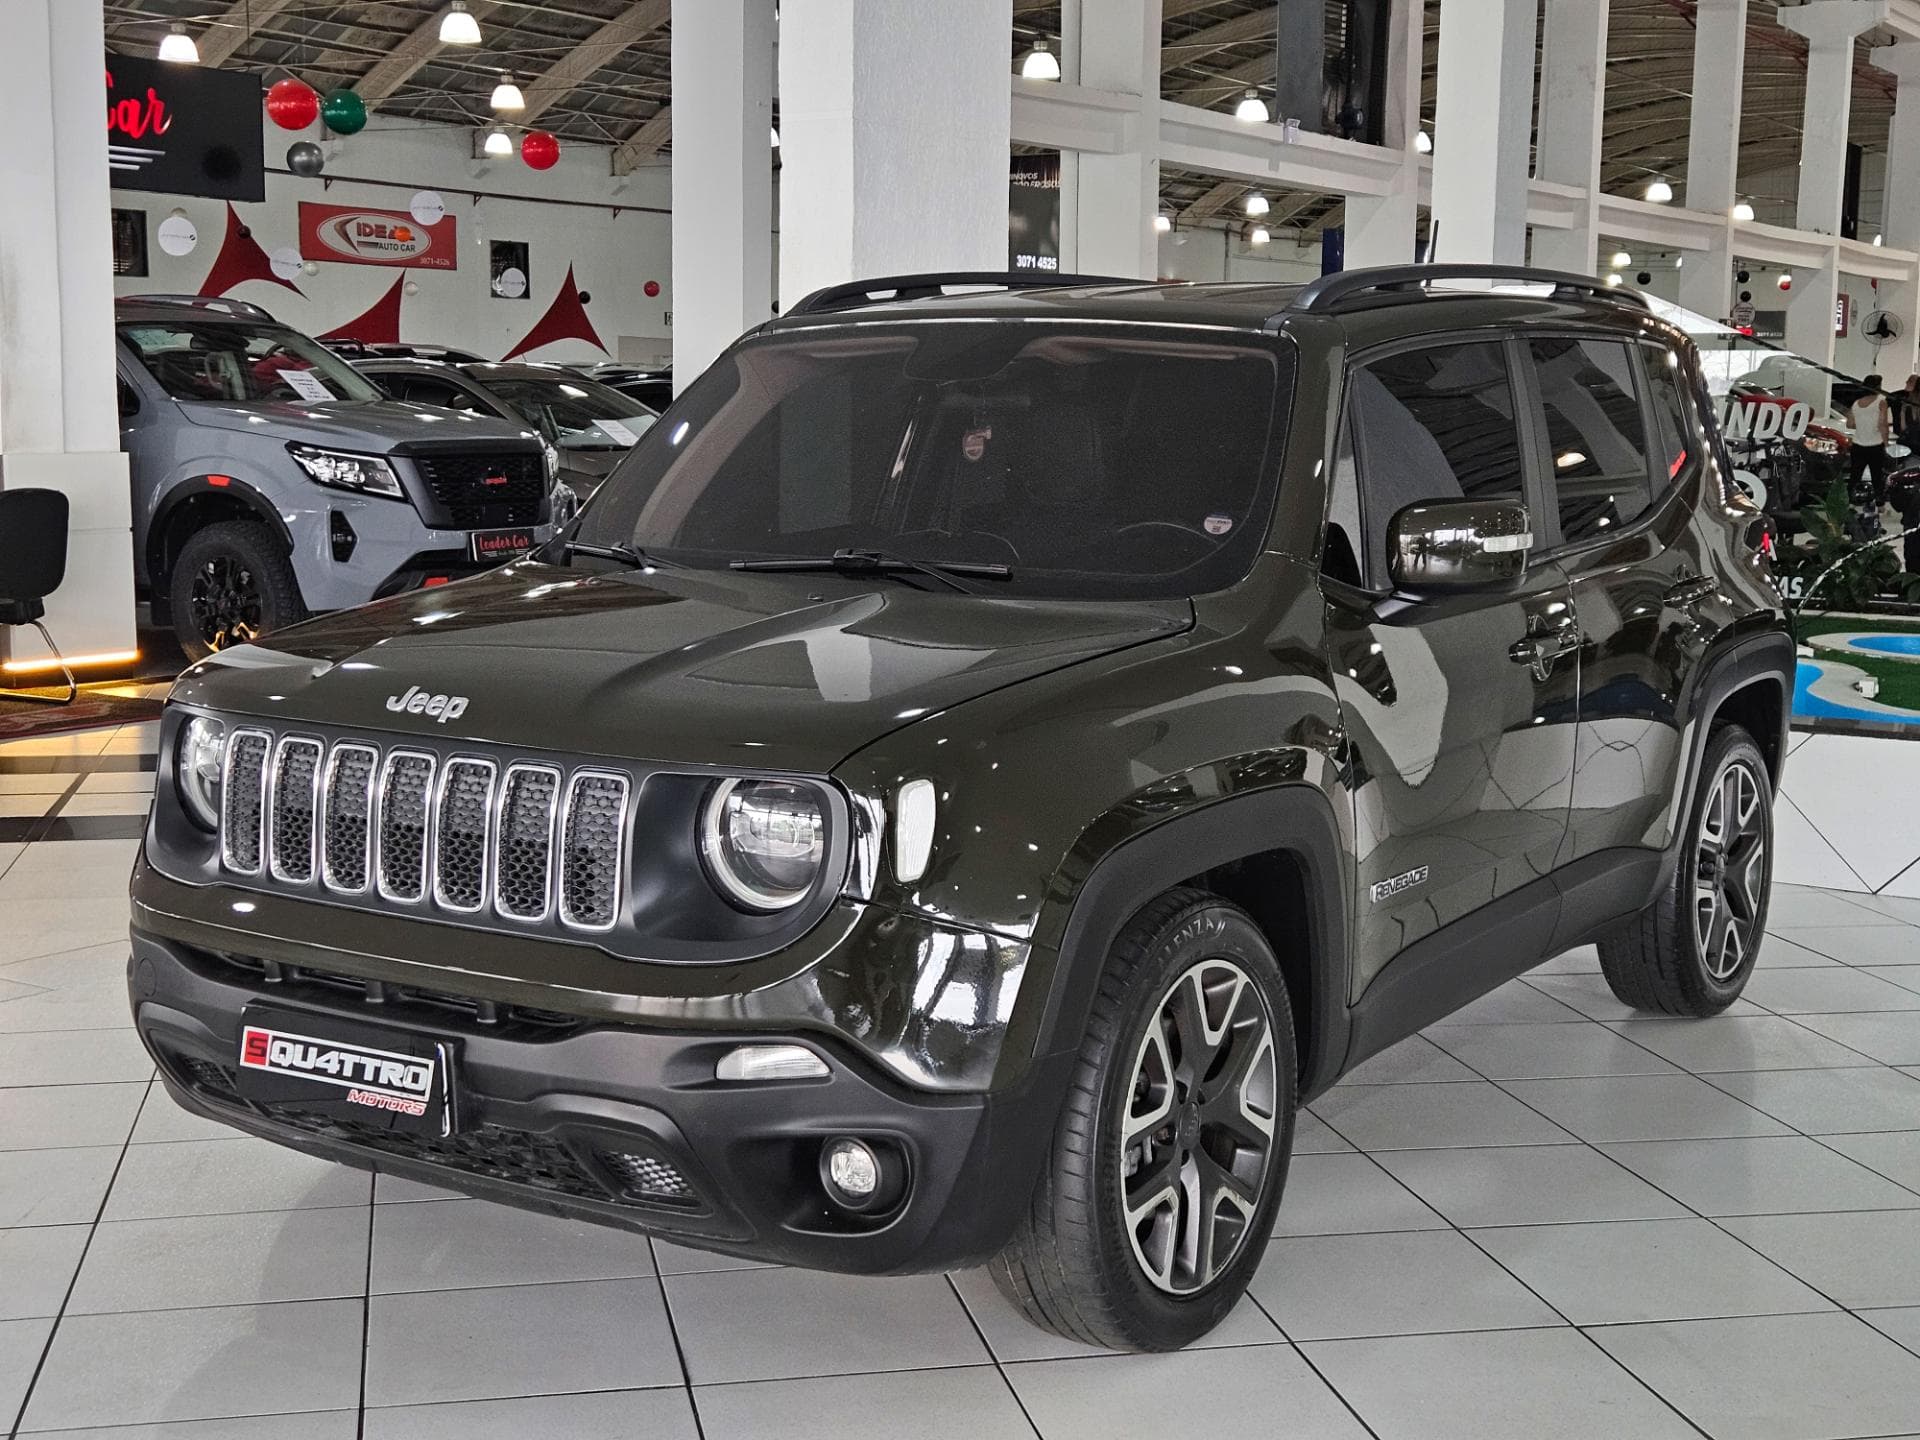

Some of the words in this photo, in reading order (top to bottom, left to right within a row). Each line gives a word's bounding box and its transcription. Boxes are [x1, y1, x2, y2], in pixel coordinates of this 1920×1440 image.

[356, 222, 416, 242] IDE
[378, 242, 399, 252] AUTO
[400, 243, 416, 252] CAR
[1016, 254, 1036, 269] 3071
[1774, 576, 1804, 599] AS
[386, 685, 469, 723] Jeep
[1373, 865, 1429, 901] RENEGADE
[346, 1089, 428, 1117] MOTORS
